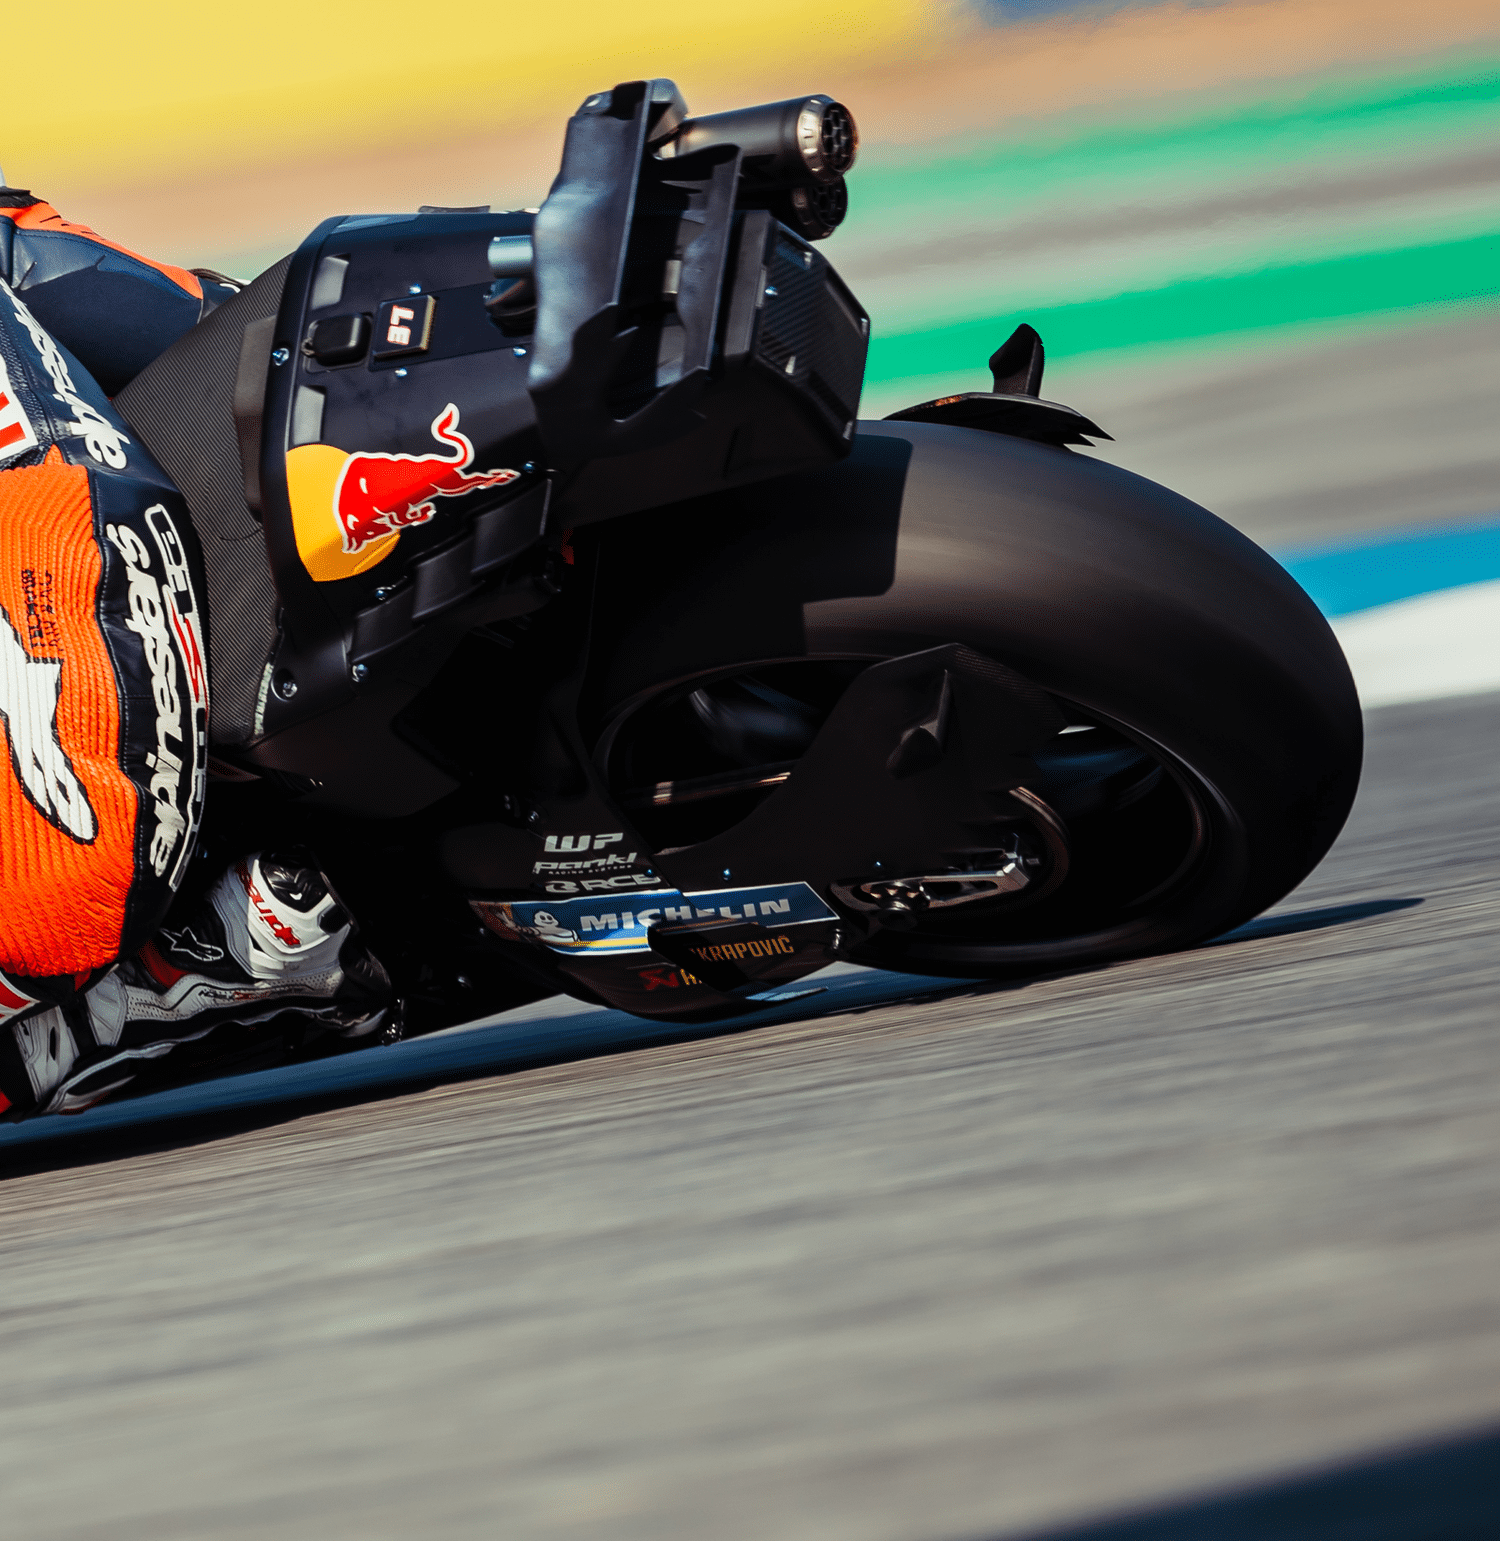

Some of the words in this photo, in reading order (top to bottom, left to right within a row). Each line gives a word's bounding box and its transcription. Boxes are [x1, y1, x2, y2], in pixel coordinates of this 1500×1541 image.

[106, 523, 184, 877] alpinestars
[544, 832, 624, 853] WP
[532, 852, 638, 874] pankl
[690, 934, 795, 962] KRAPOVIČ
